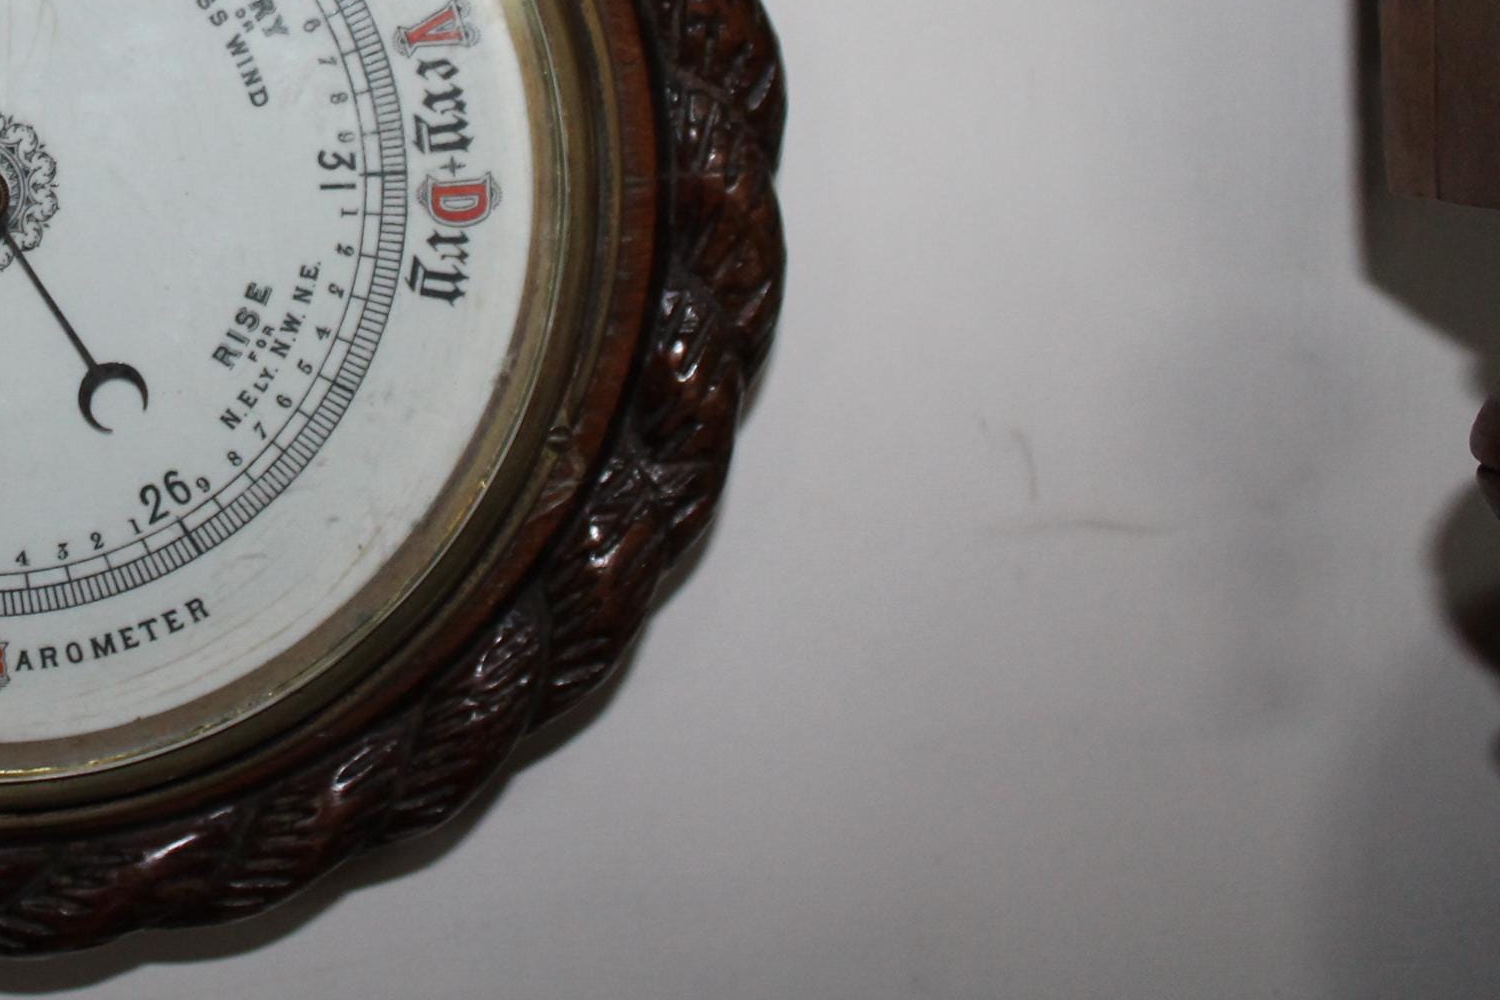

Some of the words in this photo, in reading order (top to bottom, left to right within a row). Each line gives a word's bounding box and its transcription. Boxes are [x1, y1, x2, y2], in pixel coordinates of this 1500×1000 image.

[236, 9, 254, 31] OR
[303, 18, 320, 32] 6
[318, 57, 336, 66] 7
[228, 35, 269, 107] WIND
[330, 93, 345, 104] 8
[339, 132, 352, 143] 9
[318, 149, 355, 192] 31
[341, 208, 359, 218] 1
[408, 172, 496, 306] Dry
[335, 244, 355, 257] 2
[328, 284, 345, 296] 3
[212, 282, 272, 369] RISE
[316, 326, 332, 340] 4
[250, 325, 274, 361] FOR
[298, 360, 313, 374] 5
[277, 395, 293, 409] 6
[255, 423, 269, 440] 7
[228, 451, 242, 466] 8
[196, 477, 211, 493] 9
[140, 471, 191, 524] 26
[129, 519, 141, 534] 1
[91, 532, 105, 548] 2
[58, 542, 68, 559] 3
[15, 551, 30, 566] 4
